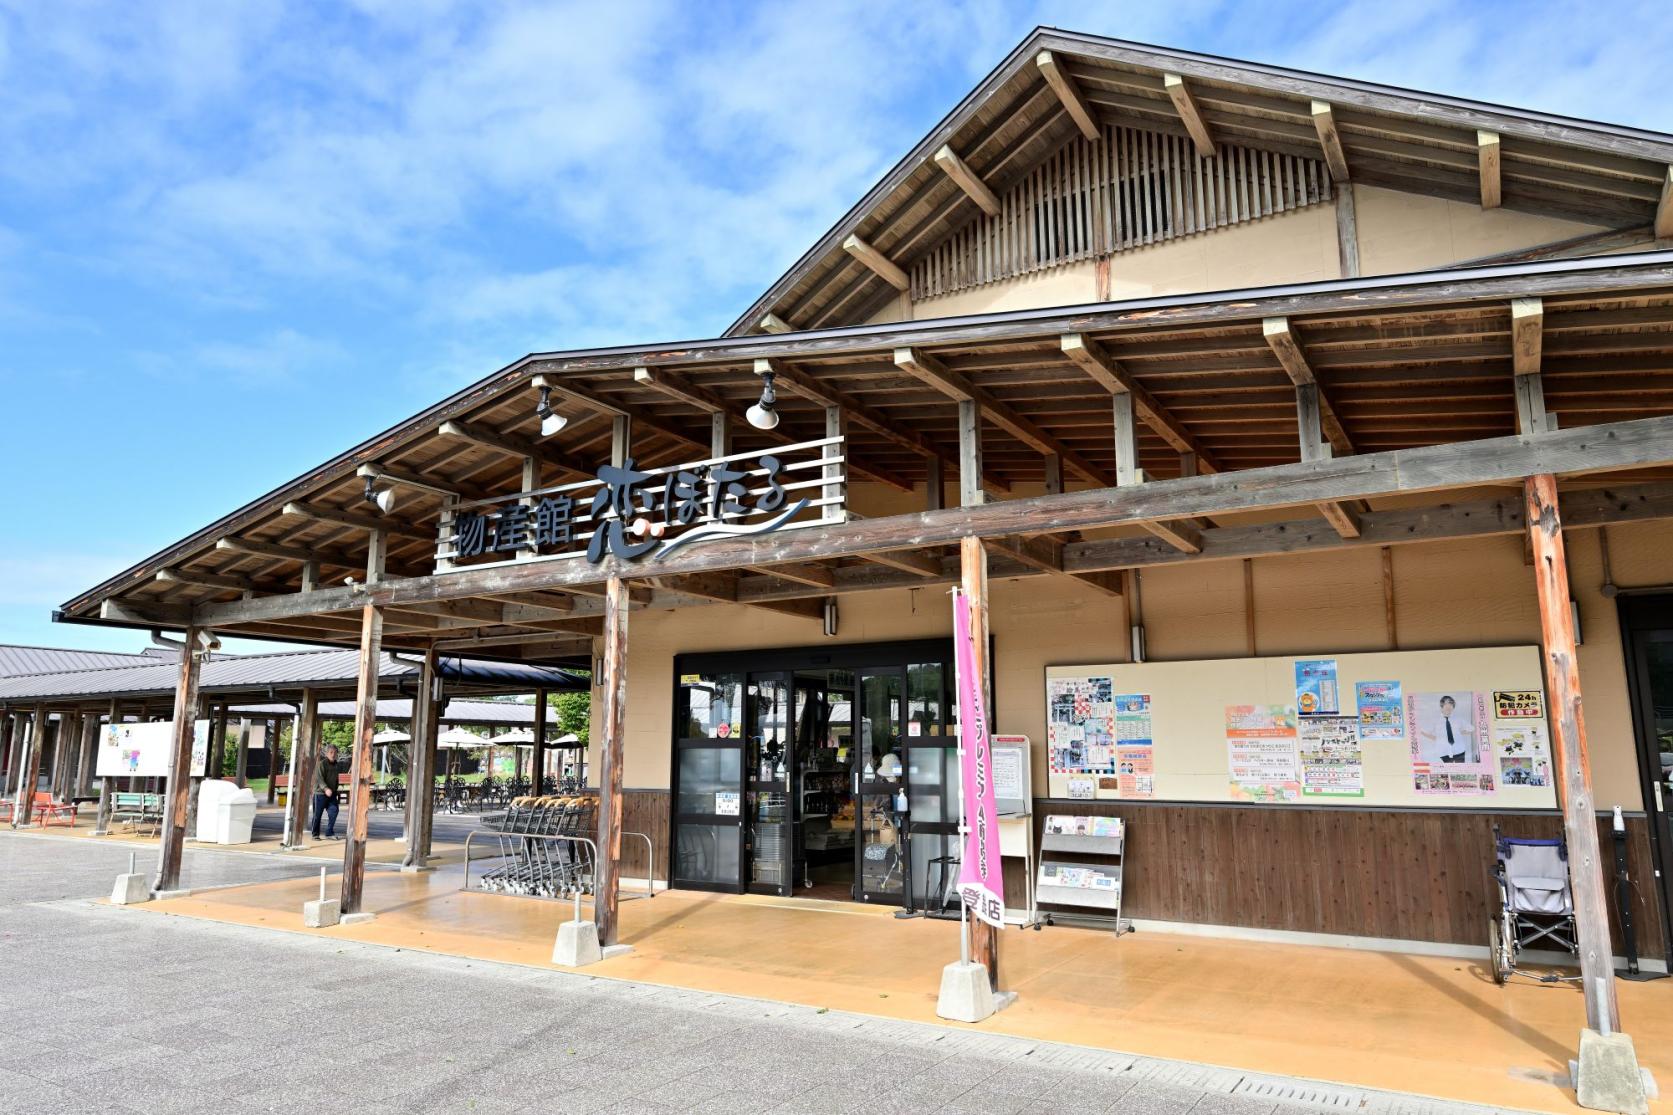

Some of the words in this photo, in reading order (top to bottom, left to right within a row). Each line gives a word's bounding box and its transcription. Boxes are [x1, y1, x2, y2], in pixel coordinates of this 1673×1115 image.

[453, 495, 573, 556] 物産館
[1517, 693, 1537, 701] 24h
[961, 886, 1001, 921] 登店
